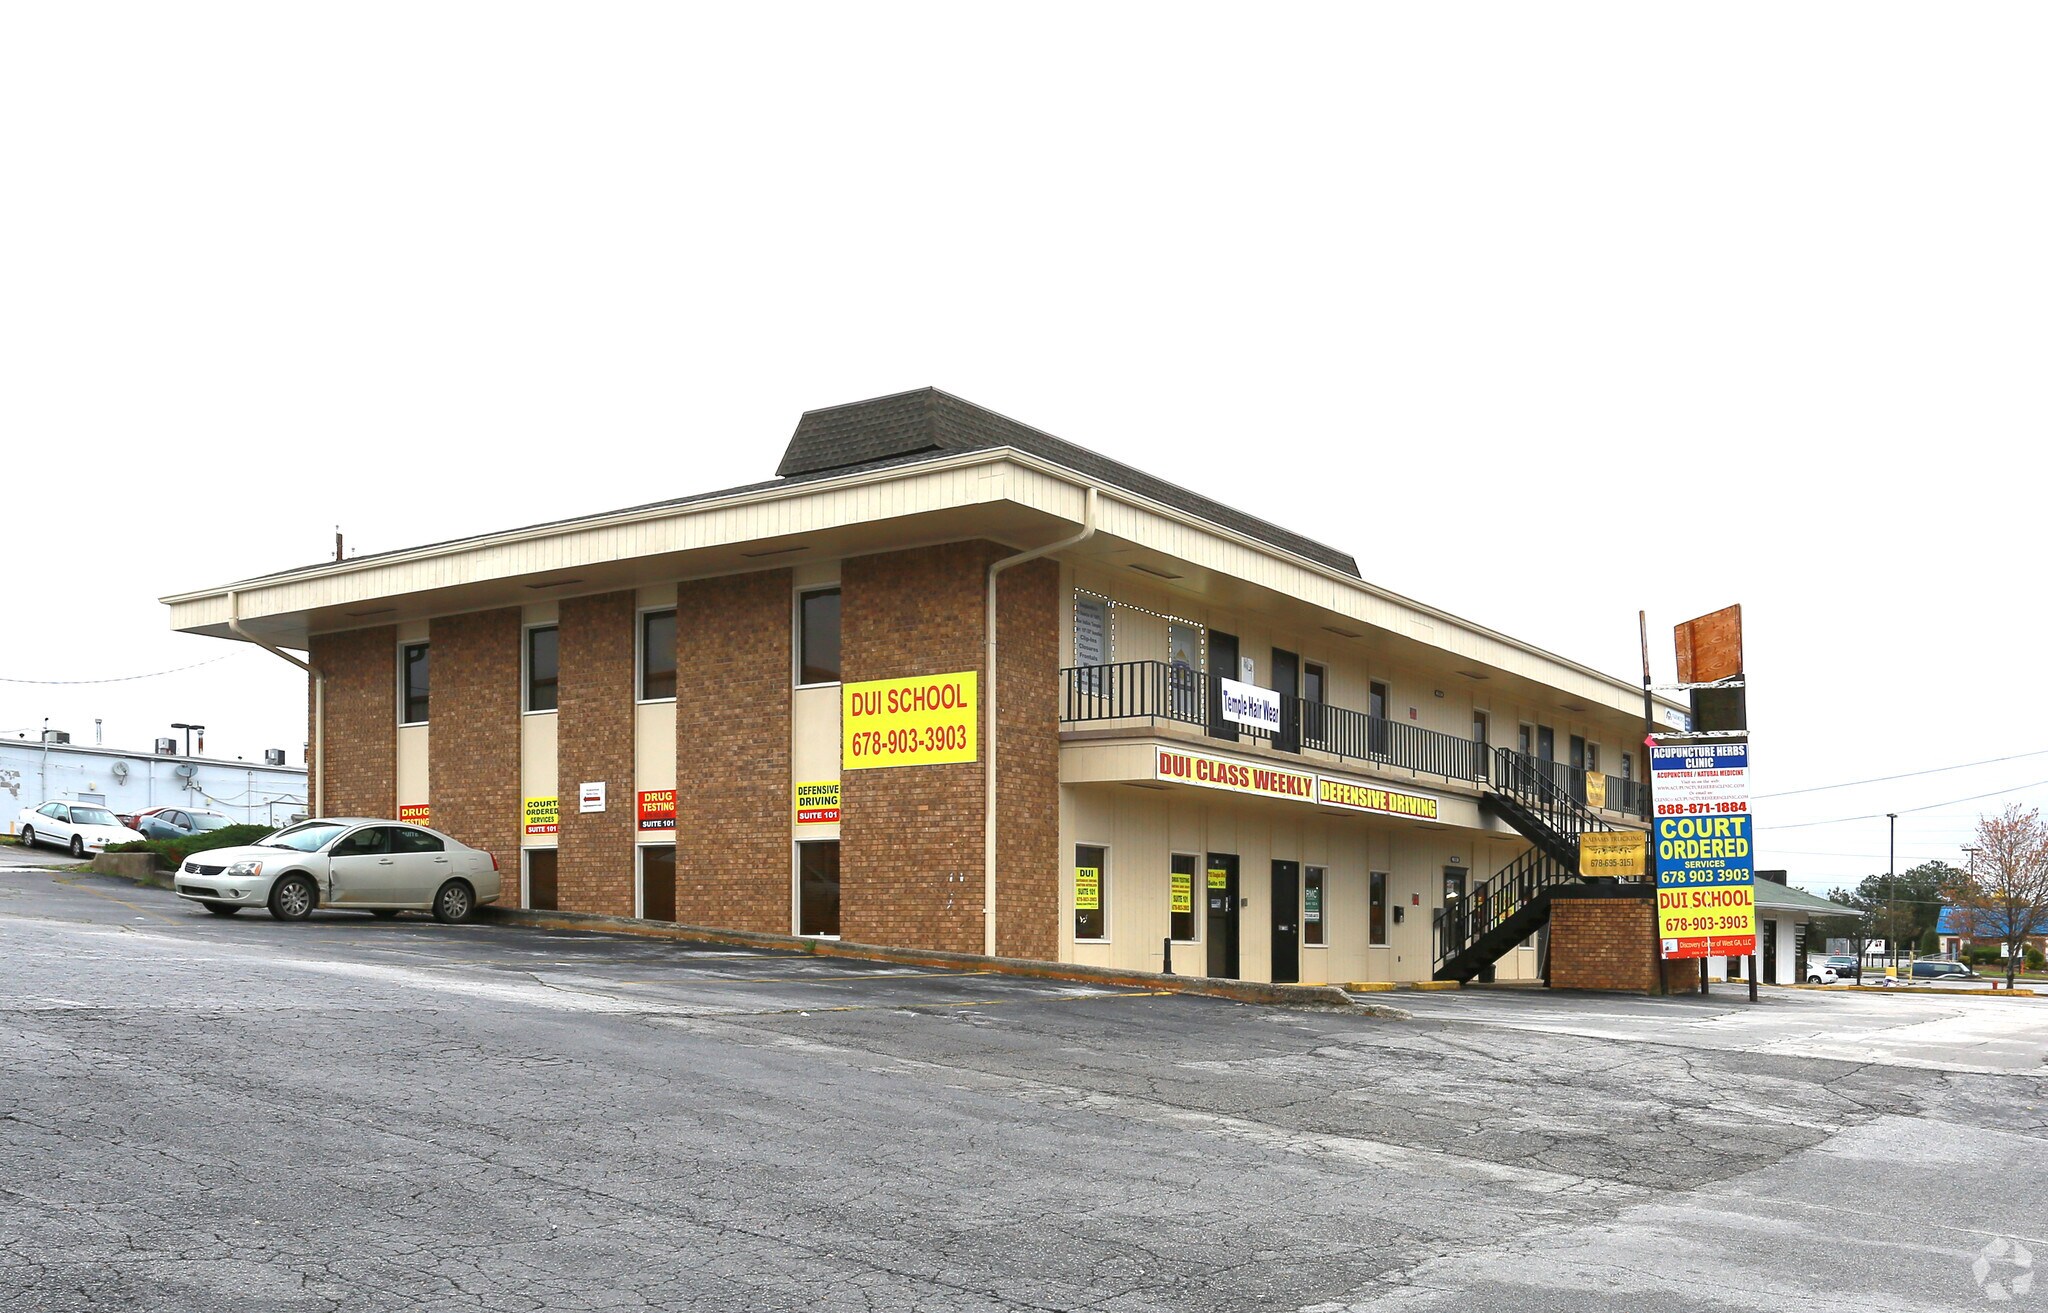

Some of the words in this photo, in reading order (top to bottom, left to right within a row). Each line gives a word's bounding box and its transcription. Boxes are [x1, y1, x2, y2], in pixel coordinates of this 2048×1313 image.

[852, 690, 882, 716] DUI
[888, 683, 968, 714] SCHOOL
[1223, 690, 1248, 720] Temple
[1248, 696, 1262, 719] Hair
[1262, 700, 1279, 723] Wear
[852, 724, 967, 756] 678-903-3903
[1654, 746, 1716, 758] ACUPUNCTURE
[1717, 746, 1744, 756] HERBS
[1686, 758, 1714, 768] CLINIC
[1160, 753, 1191, 777] DUI
[1196, 759, 1249, 788] CLASS
[1254, 770, 1312, 797] WEEKLY
[1657, 770, 1692, 778] ACUPUNCTURE
[1697, 770, 1718, 778] NATURAL
[798, 785, 839, 796] DEFENSIVE
[644, 792, 672, 802] DRUG
[800, 796, 838, 806] DRIVING
[1320, 780, 1387, 810] DEFENSIVE
[1388, 793, 1437, 818] DRIVING
[402, 808, 430, 816] DRUG
[526, 808, 558, 816] ORDERED
[642, 802, 674, 812] TESTING
[1658, 802, 1747, 814] 888-871-1884
[530, 816, 554, 824] SERVICES
[799, 812, 822, 820] SUITE
[642, 820, 662, 828] SUITE
[1660, 817, 1746, 838] COURT
[1660, 838, 1748, 860] ORDERED
[1684, 860, 1726, 868] SERVICES
[1662, 870, 1686, 884] 678
[1689, 870, 1714, 882] 903
[1717, 868, 1750, 882] 3903
[1306, 890, 1317, 898] RMC
[1660, 892, 1688, 909] DUI
[1692, 890, 1752, 908] SCHOOL
[1666, 915, 1748, 932] 678-903-3903
